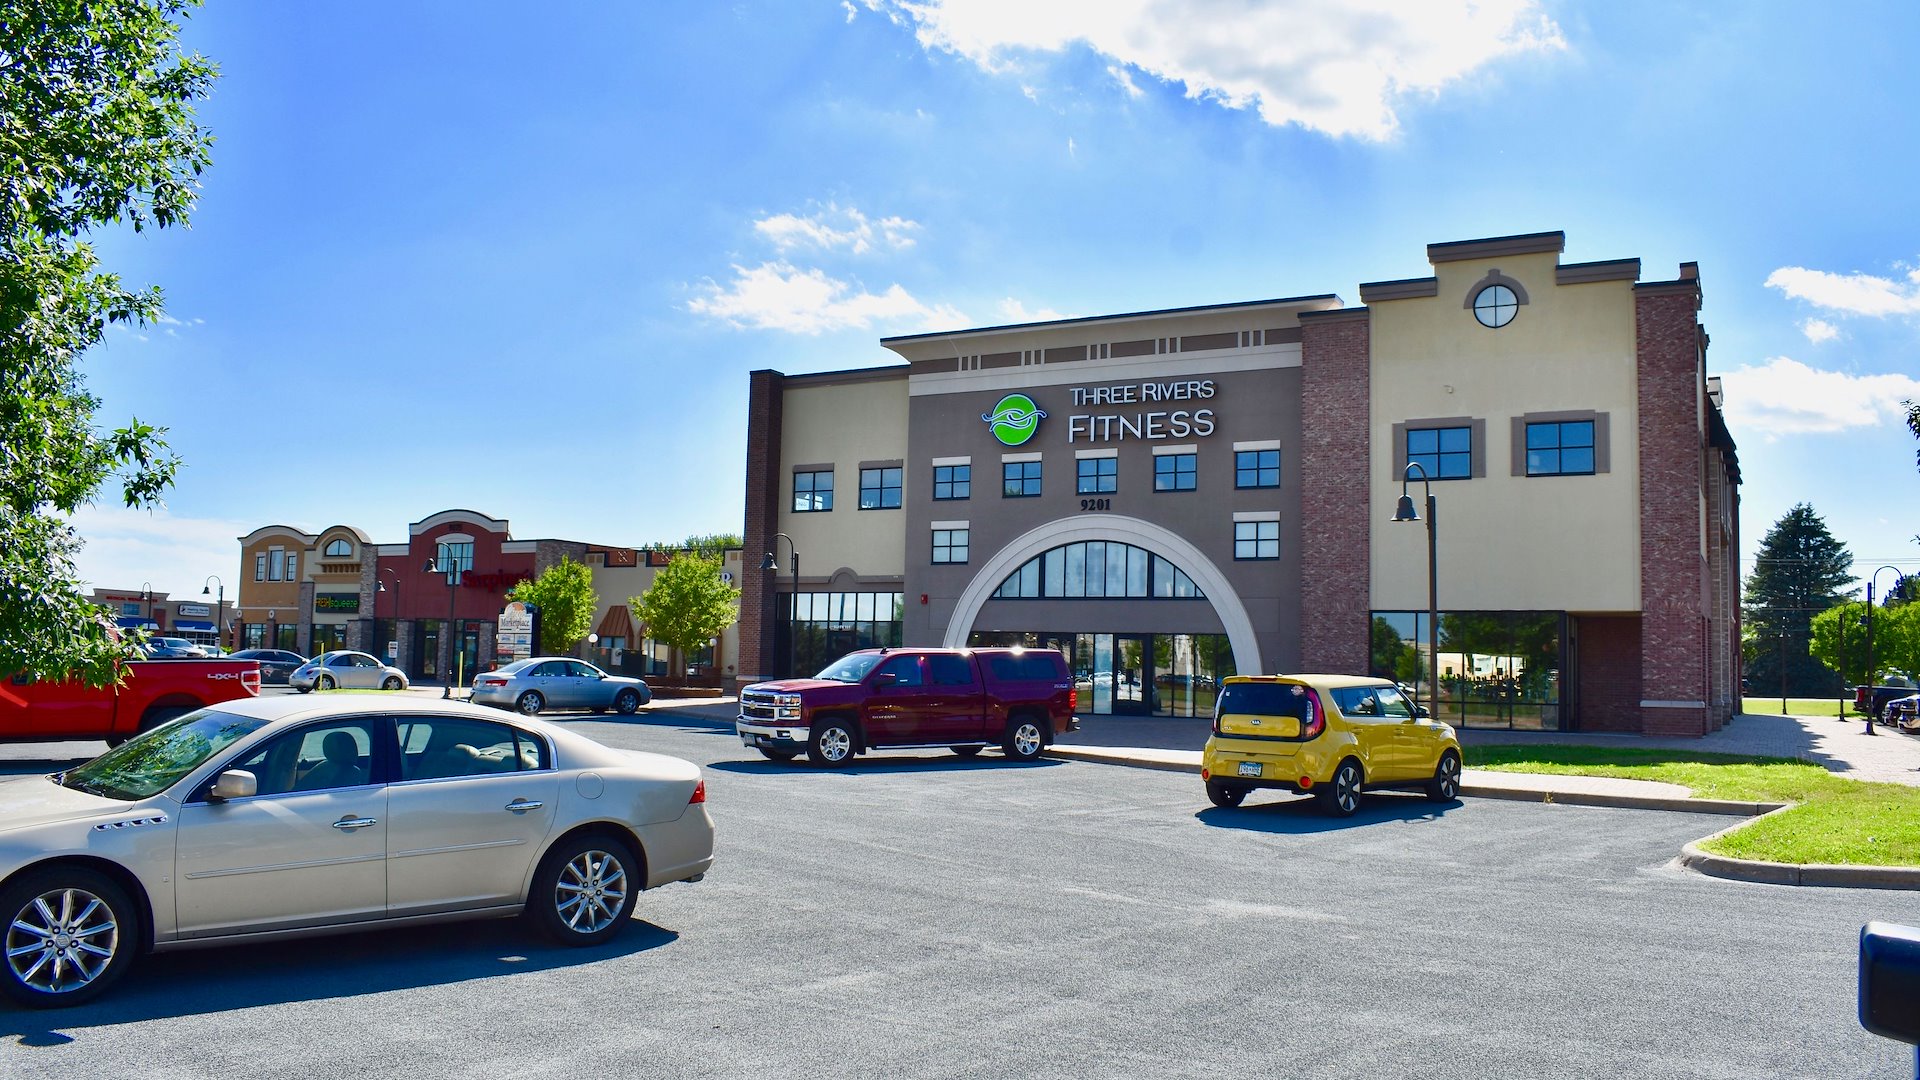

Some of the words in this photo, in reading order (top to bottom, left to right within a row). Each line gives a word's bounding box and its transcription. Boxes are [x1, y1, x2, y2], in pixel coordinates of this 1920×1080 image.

[1069, 385, 1137, 406] THREE
[1142, 380, 1215, 402] RIVERS
[1068, 409, 1215, 443] FITNESS
[1080, 498, 1111, 511] 9201
